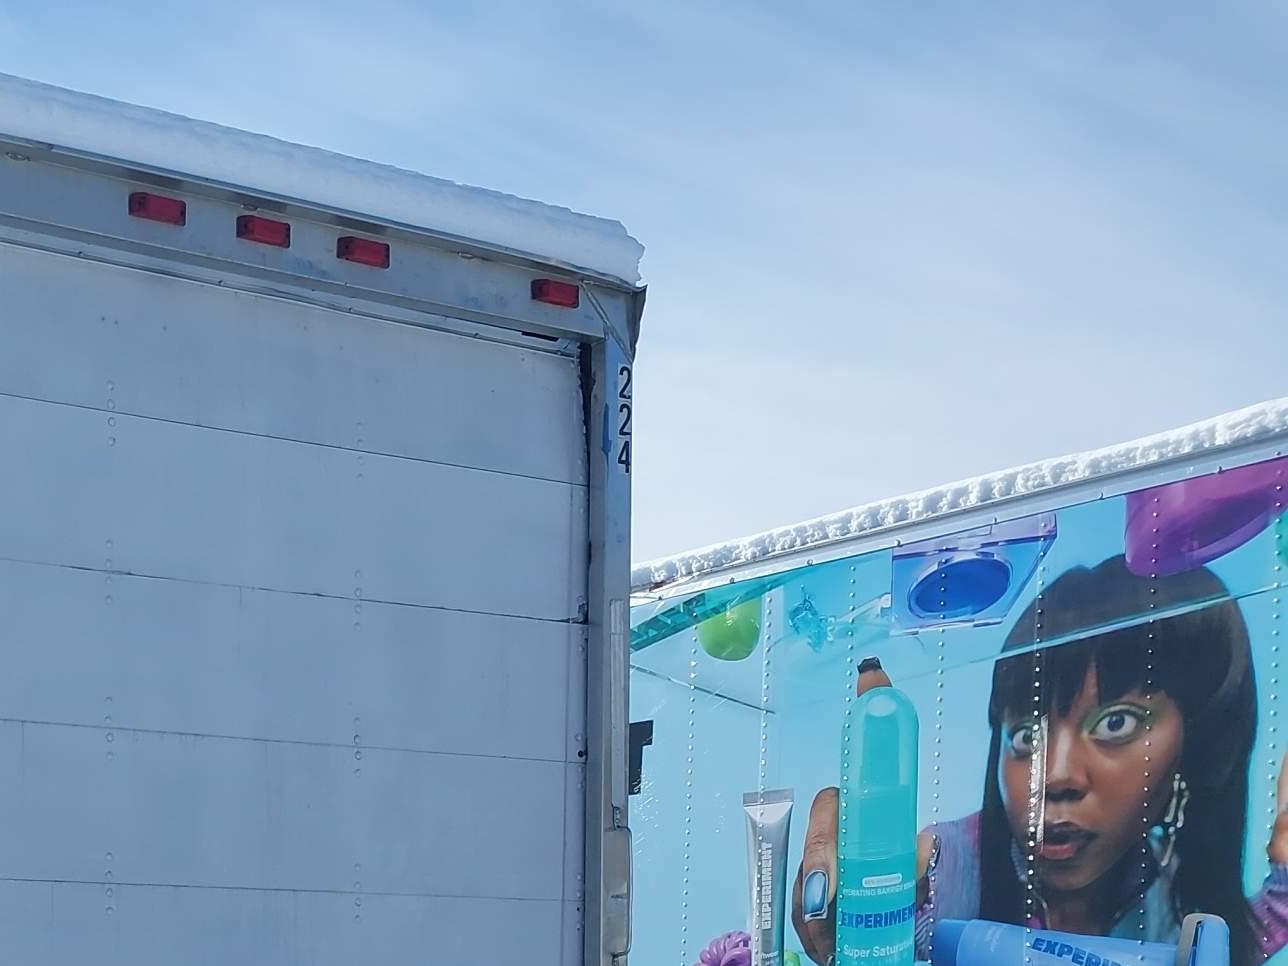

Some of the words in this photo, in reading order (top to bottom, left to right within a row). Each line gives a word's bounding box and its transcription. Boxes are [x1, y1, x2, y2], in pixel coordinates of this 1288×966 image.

[617, 365, 632, 474] 224
[761, 841, 773, 930] EXPERIMENT
[843, 943, 870, 960] Super
